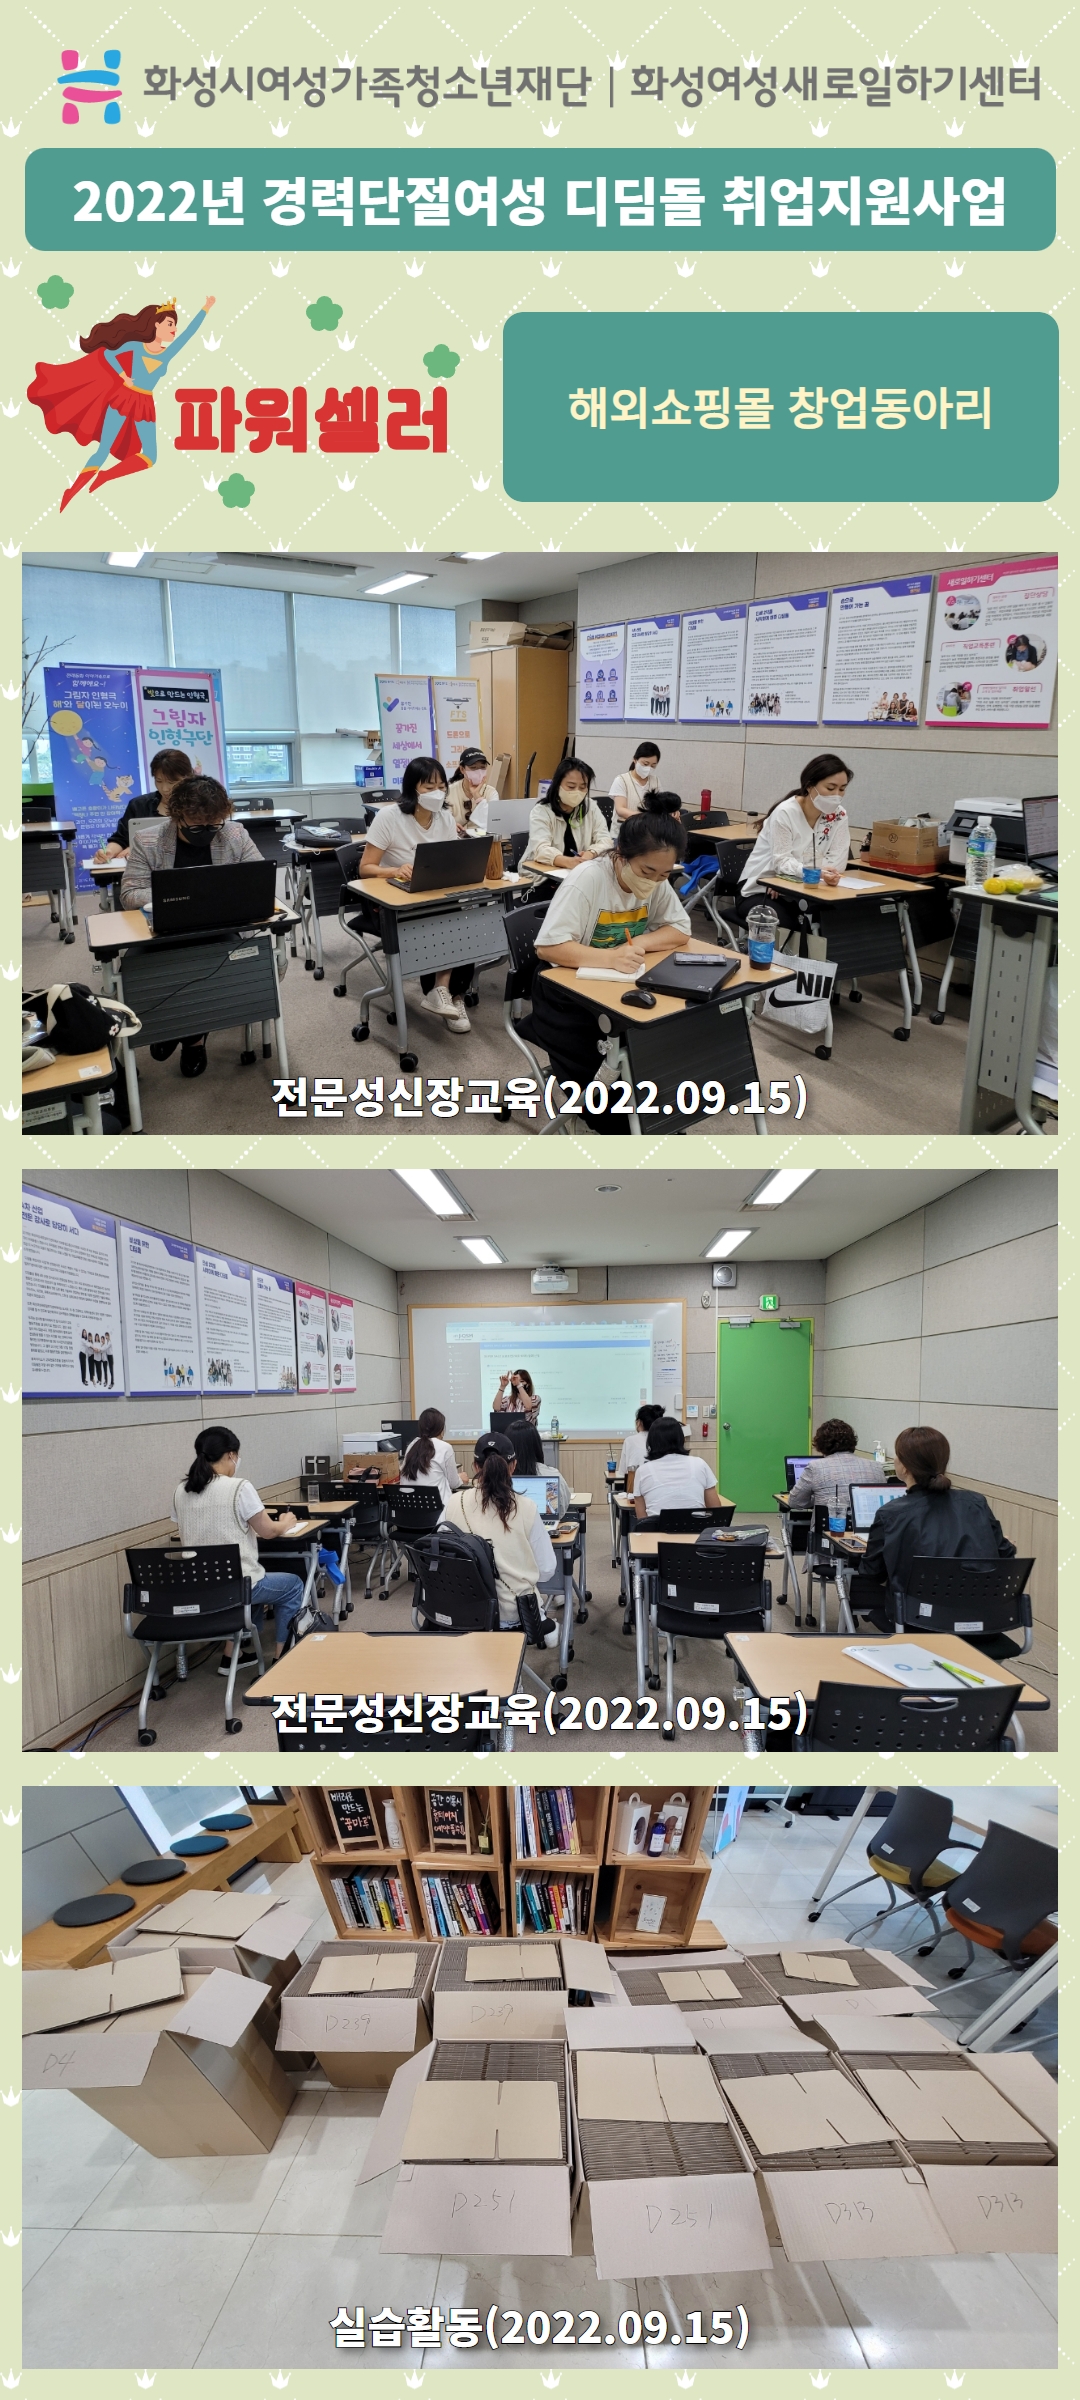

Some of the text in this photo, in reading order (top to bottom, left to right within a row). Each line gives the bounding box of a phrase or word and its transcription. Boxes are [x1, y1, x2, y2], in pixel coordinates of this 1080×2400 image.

[64, 691, 117, 700] 그림자 인형극
[152, 709, 207, 728] 그림자
[149, 728, 213, 747] 인형극단
[393, 741, 422, 751] 세상에서
[341, 1803, 364, 1814] 만드는
[431, 1793, 444, 1806] 공간
[471, 2004, 514, 2025] D239
[324, 2013, 371, 2037] D239
[450, 2188, 516, 2219] D251
[645, 2203, 714, 2233] D251
